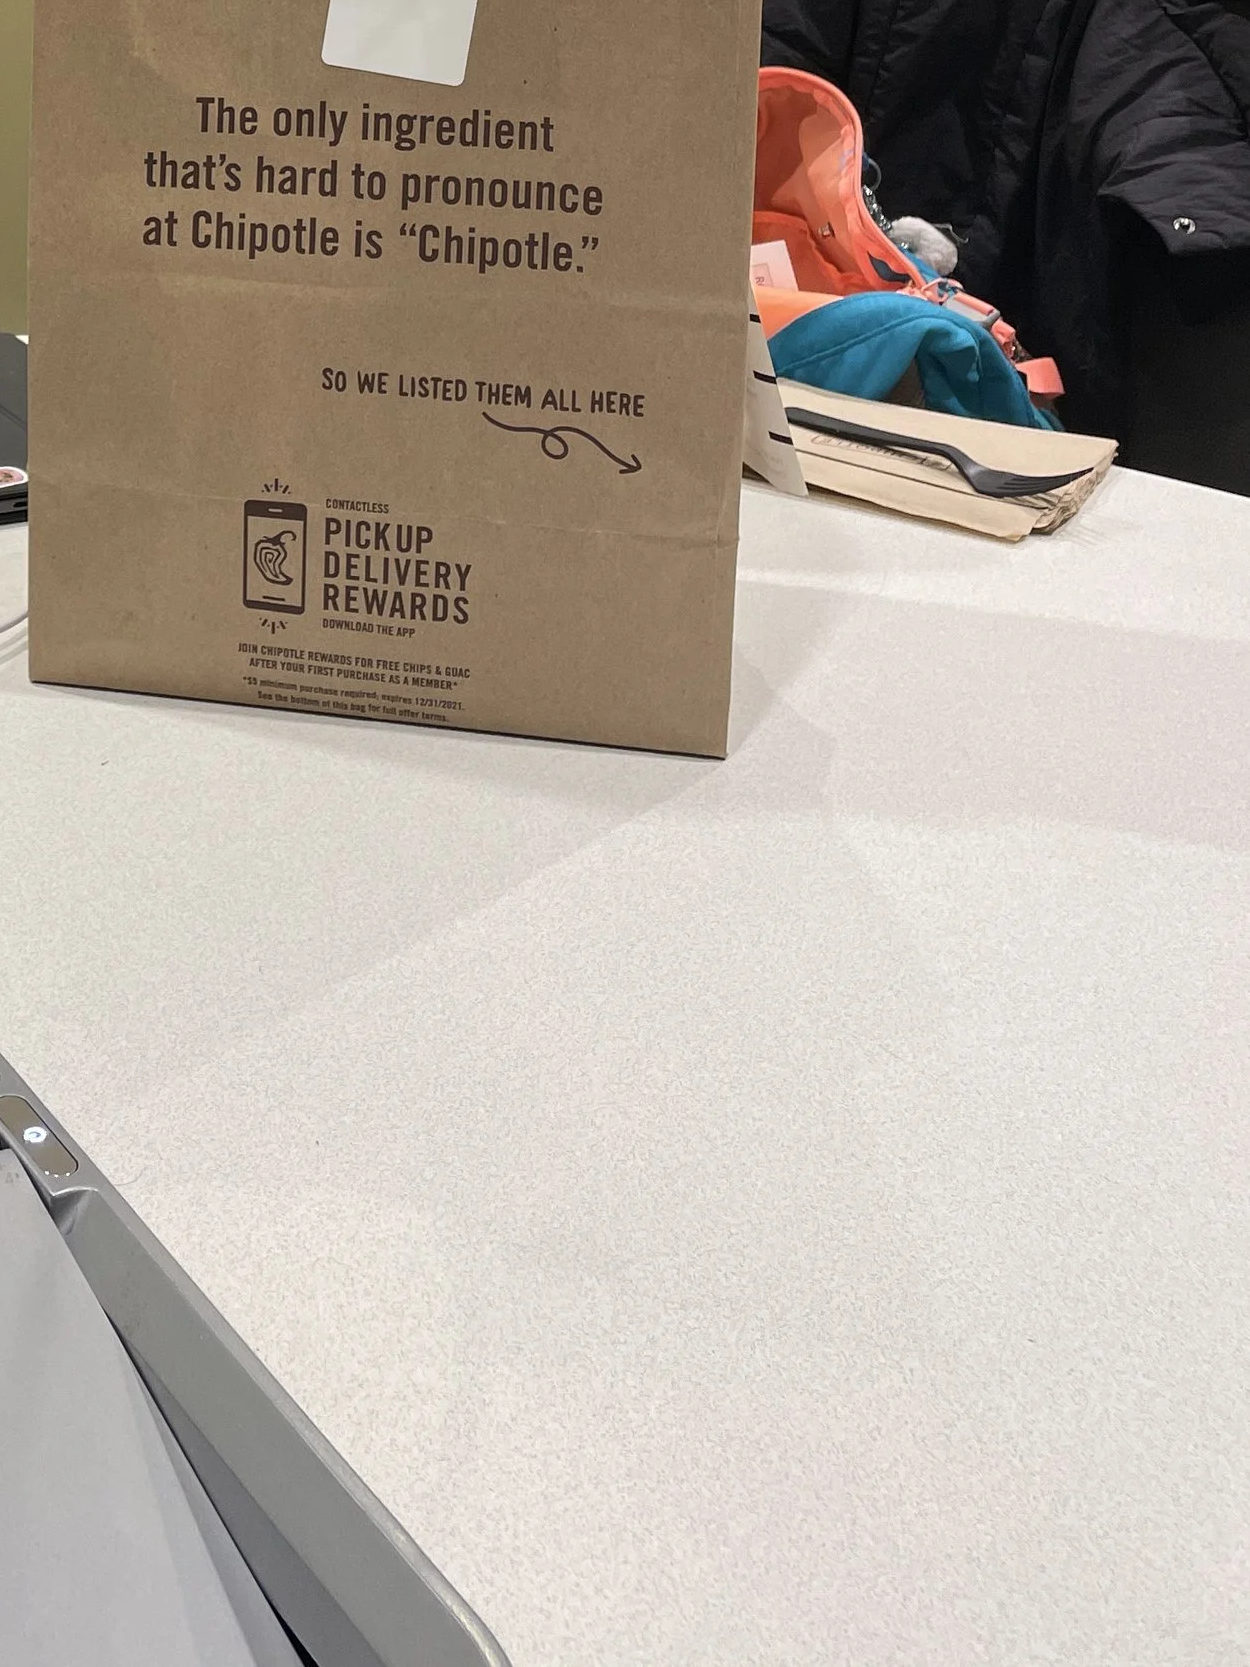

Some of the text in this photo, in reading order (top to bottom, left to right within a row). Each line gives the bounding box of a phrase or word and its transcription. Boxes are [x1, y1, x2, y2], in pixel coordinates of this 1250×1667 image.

[195, 97, 554, 152] The only ingredient
[144, 151, 603, 215] that’s hard to pronounce
[143, 210, 599, 273] at Chipotle is “Chipotle.”
[322, 367, 645, 417] SO WE LISTED THEM ALL HERE
[325, 498, 389, 514] CONTACTLESS
[324, 517, 433, 554] PICKUP
[324, 551, 472, 592] DELIVERY
[323, 583, 469, 624] REWARDS
[322, 618, 416, 638] DOWNLOAD THE APP
[238, 643, 470, 678] JOIN CHIPOTLE REWARDS FOR FREE CHIPS & GUAC
[249, 658, 277, 669] AFTER
[280, 661, 305, 673] YOUR
[307, 665, 334, 677] FIRST
[336, 668, 386, 683] PURCHASE
[389, 675, 401, 685] AS
[403, 676, 409, 686] A
[257, 691, 273, 700] See
[275, 693, 288, 702] the
[291, 695, 320, 707] bottom
[322, 699, 331, 708] of
[333, 700, 348, 710] this
[350, 703, 366, 713] bag
[368, 704, 381, 712] for
[383, 705, 396, 716] full
[399, 708, 420, 718] offer
[259, 679, 298, 691] minimum
[300, 684, 338, 696] purchase
[381, 694, 412, 705] expires
